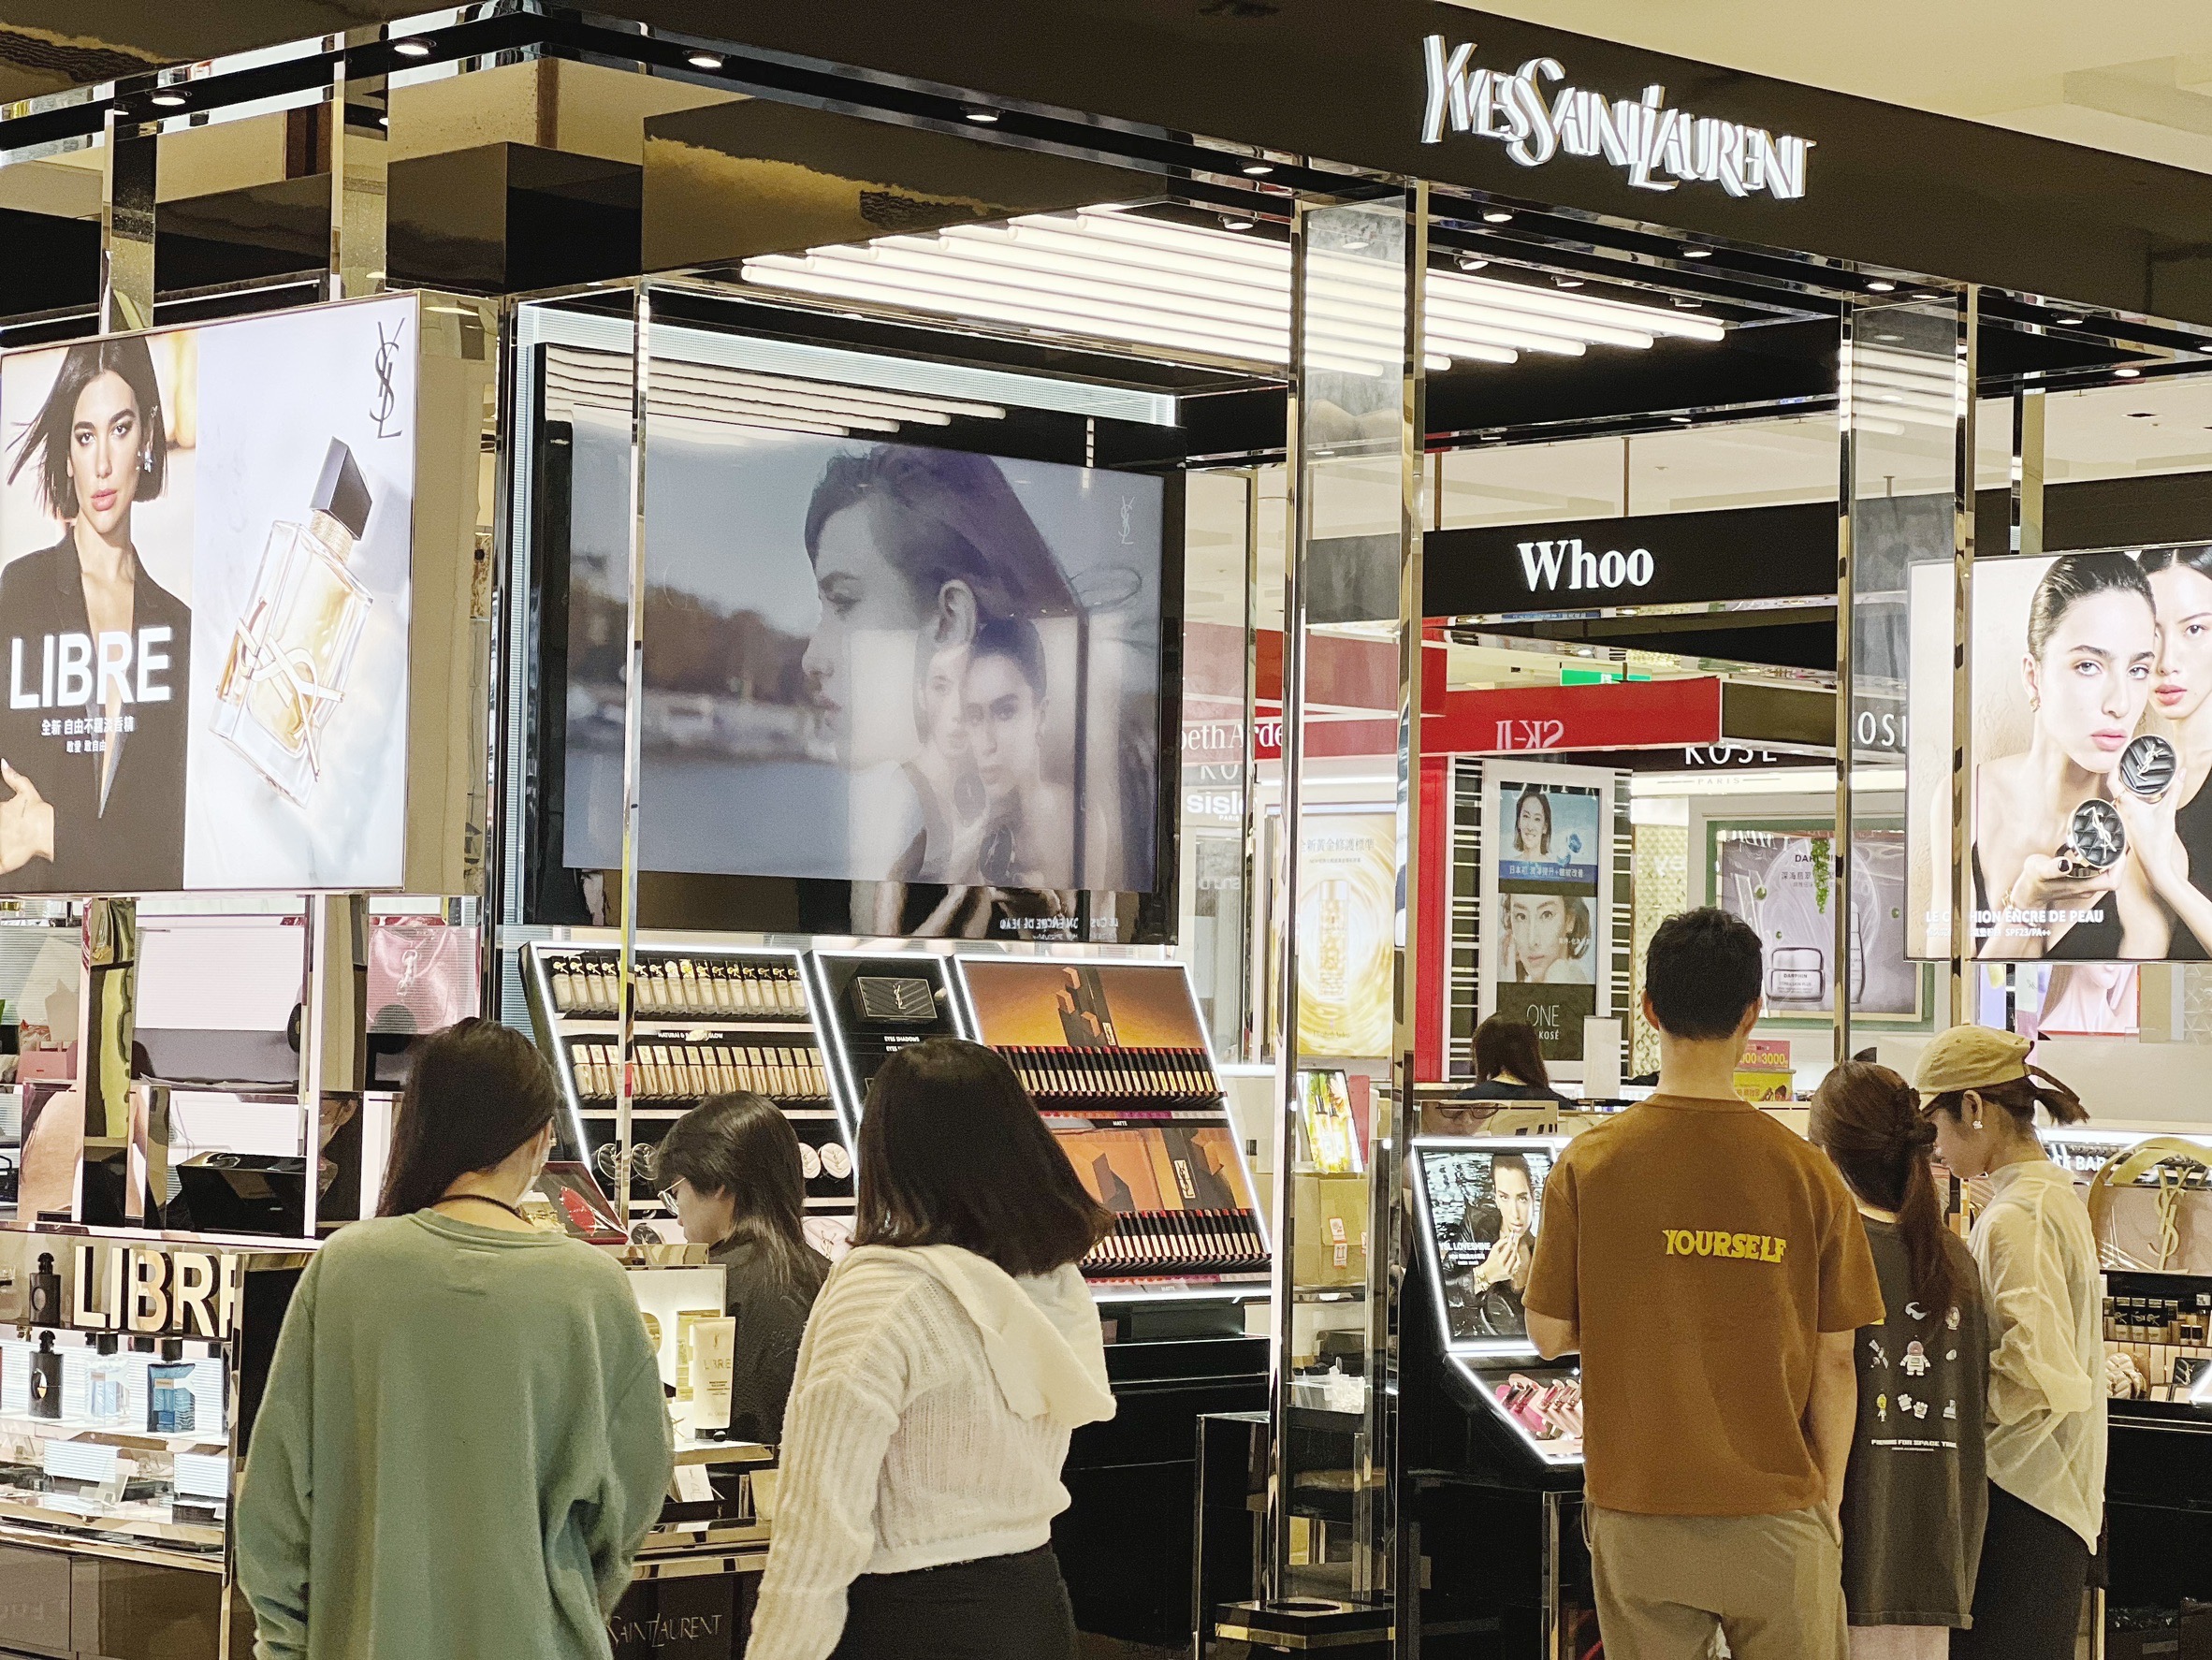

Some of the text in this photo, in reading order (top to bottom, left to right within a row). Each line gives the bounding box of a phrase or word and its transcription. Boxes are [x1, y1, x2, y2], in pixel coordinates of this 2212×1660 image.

[1517, 539, 1654, 591] Whoo
[10, 626, 171, 708] LIBRE
[41, 720, 62, 735] 全新
[2005, 910, 2046, 924] ENCRE
[2048, 911, 2066, 923] DE
[2070, 909, 2104, 923] PEAU
[1526, 1004, 1561, 1027] ONE
[1662, 1229, 1786, 1263] YOURSELF
